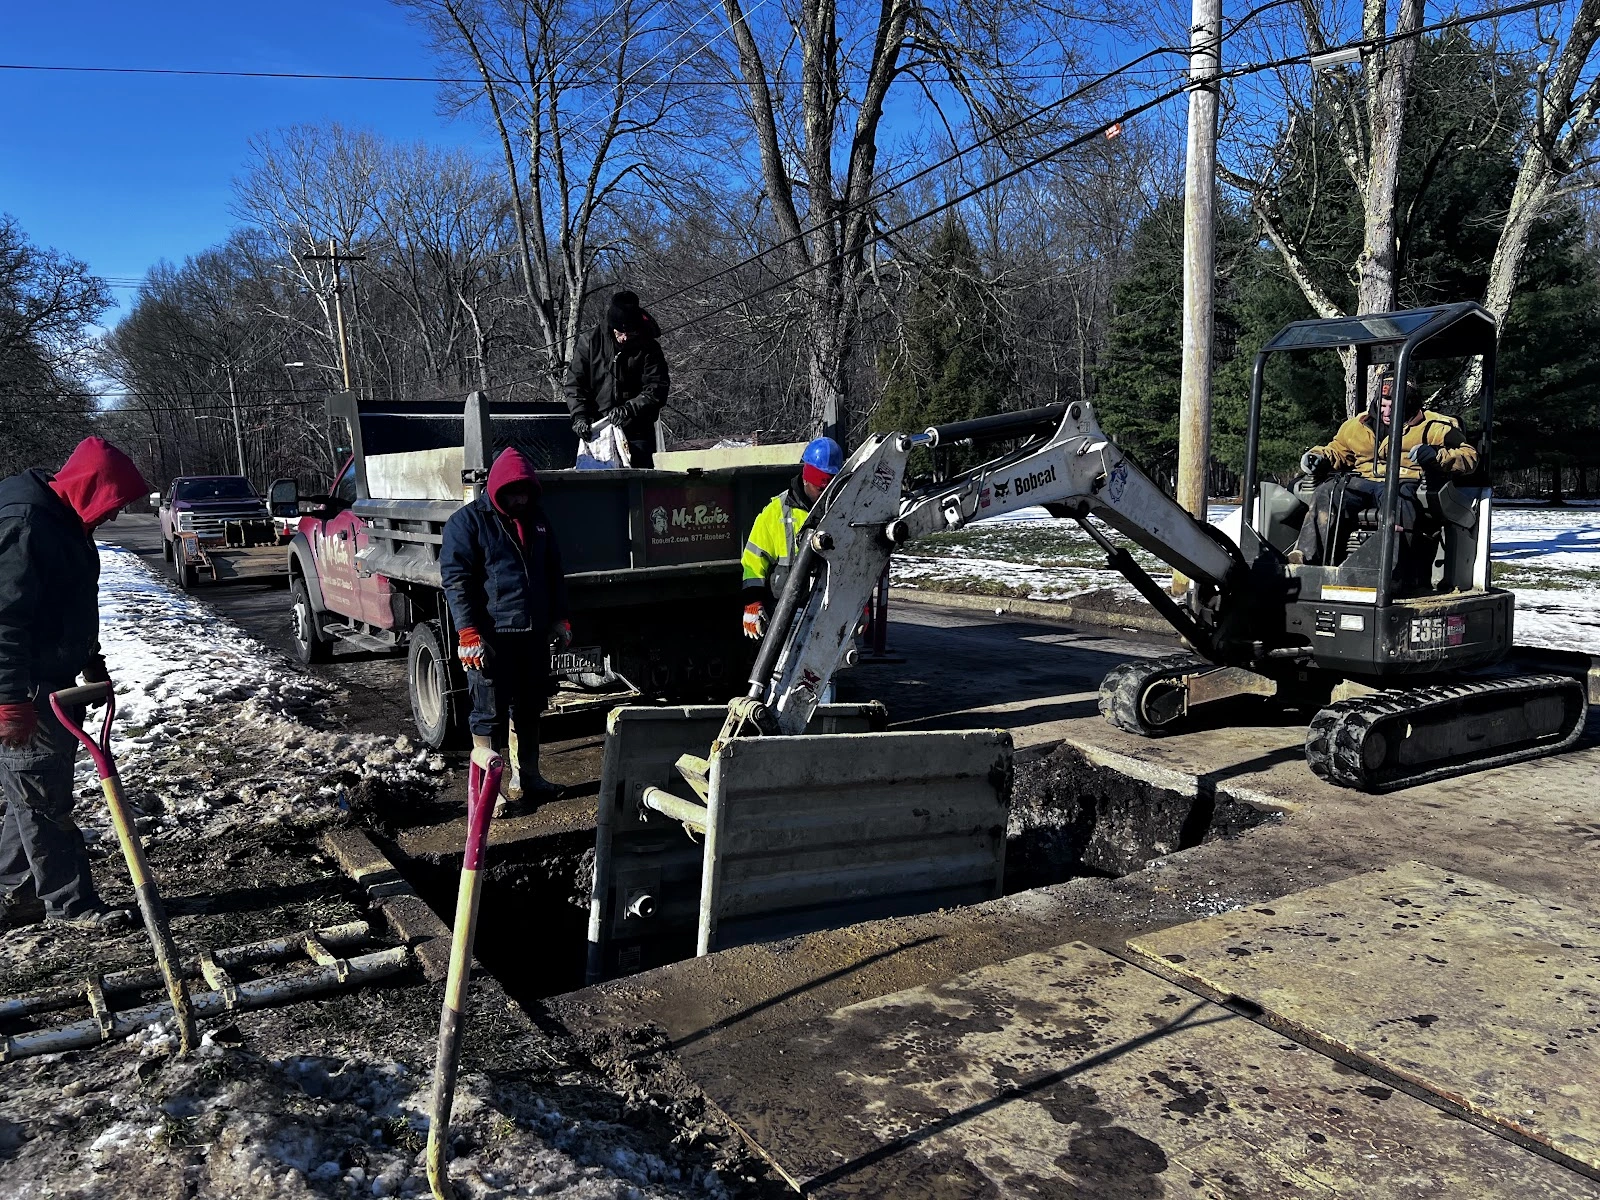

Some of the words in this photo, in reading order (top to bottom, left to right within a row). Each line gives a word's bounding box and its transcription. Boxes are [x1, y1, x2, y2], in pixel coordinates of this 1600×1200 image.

[1014, 464, 1057, 496] Bobcat
[671, 507, 695, 528] Mr.
[694, 504, 730, 525] Rooter
[691, 532, 731, 542] 877-Rooter-2
